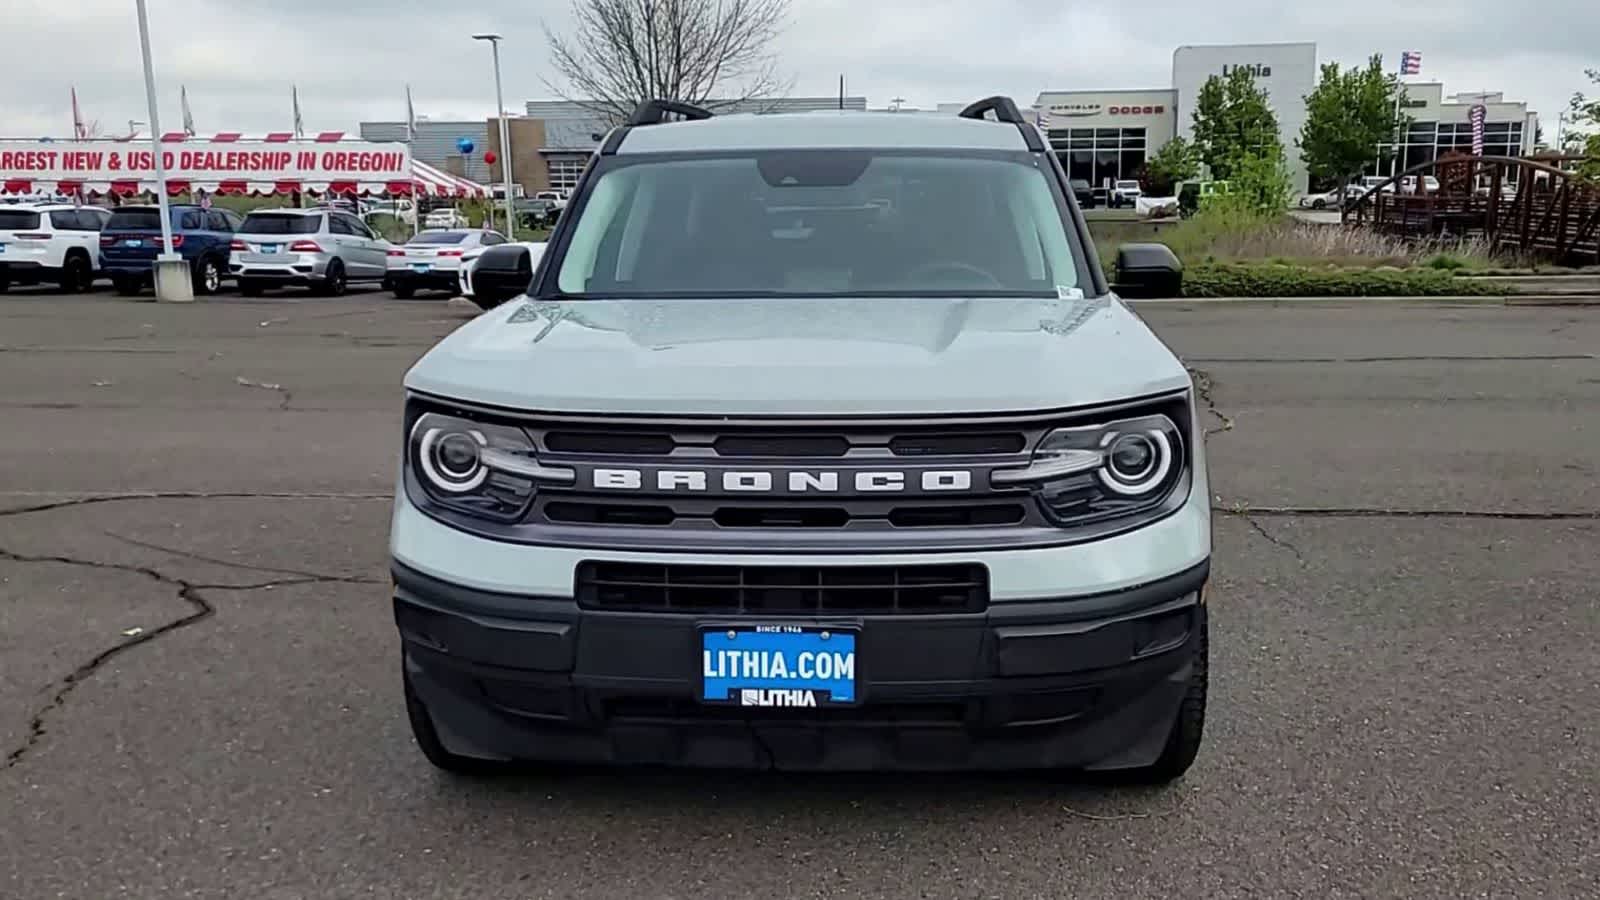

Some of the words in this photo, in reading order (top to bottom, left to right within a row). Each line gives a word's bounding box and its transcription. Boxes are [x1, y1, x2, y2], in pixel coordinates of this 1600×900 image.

[1109, 106, 1164, 114] DODGE
[0, 151, 58, 170] RGEST
[62, 151, 103, 170] NEW
[107, 151, 122, 170] &
[179, 151, 291, 171] DEALERSHIP
[297, 151, 316, 170] IN
[321, 151, 404, 172] OREGON!
[592, 468, 972, 493] BRONCO
[703, 650, 855, 680] LITHIA.COM
[758, 689, 817, 707] LITHIA
